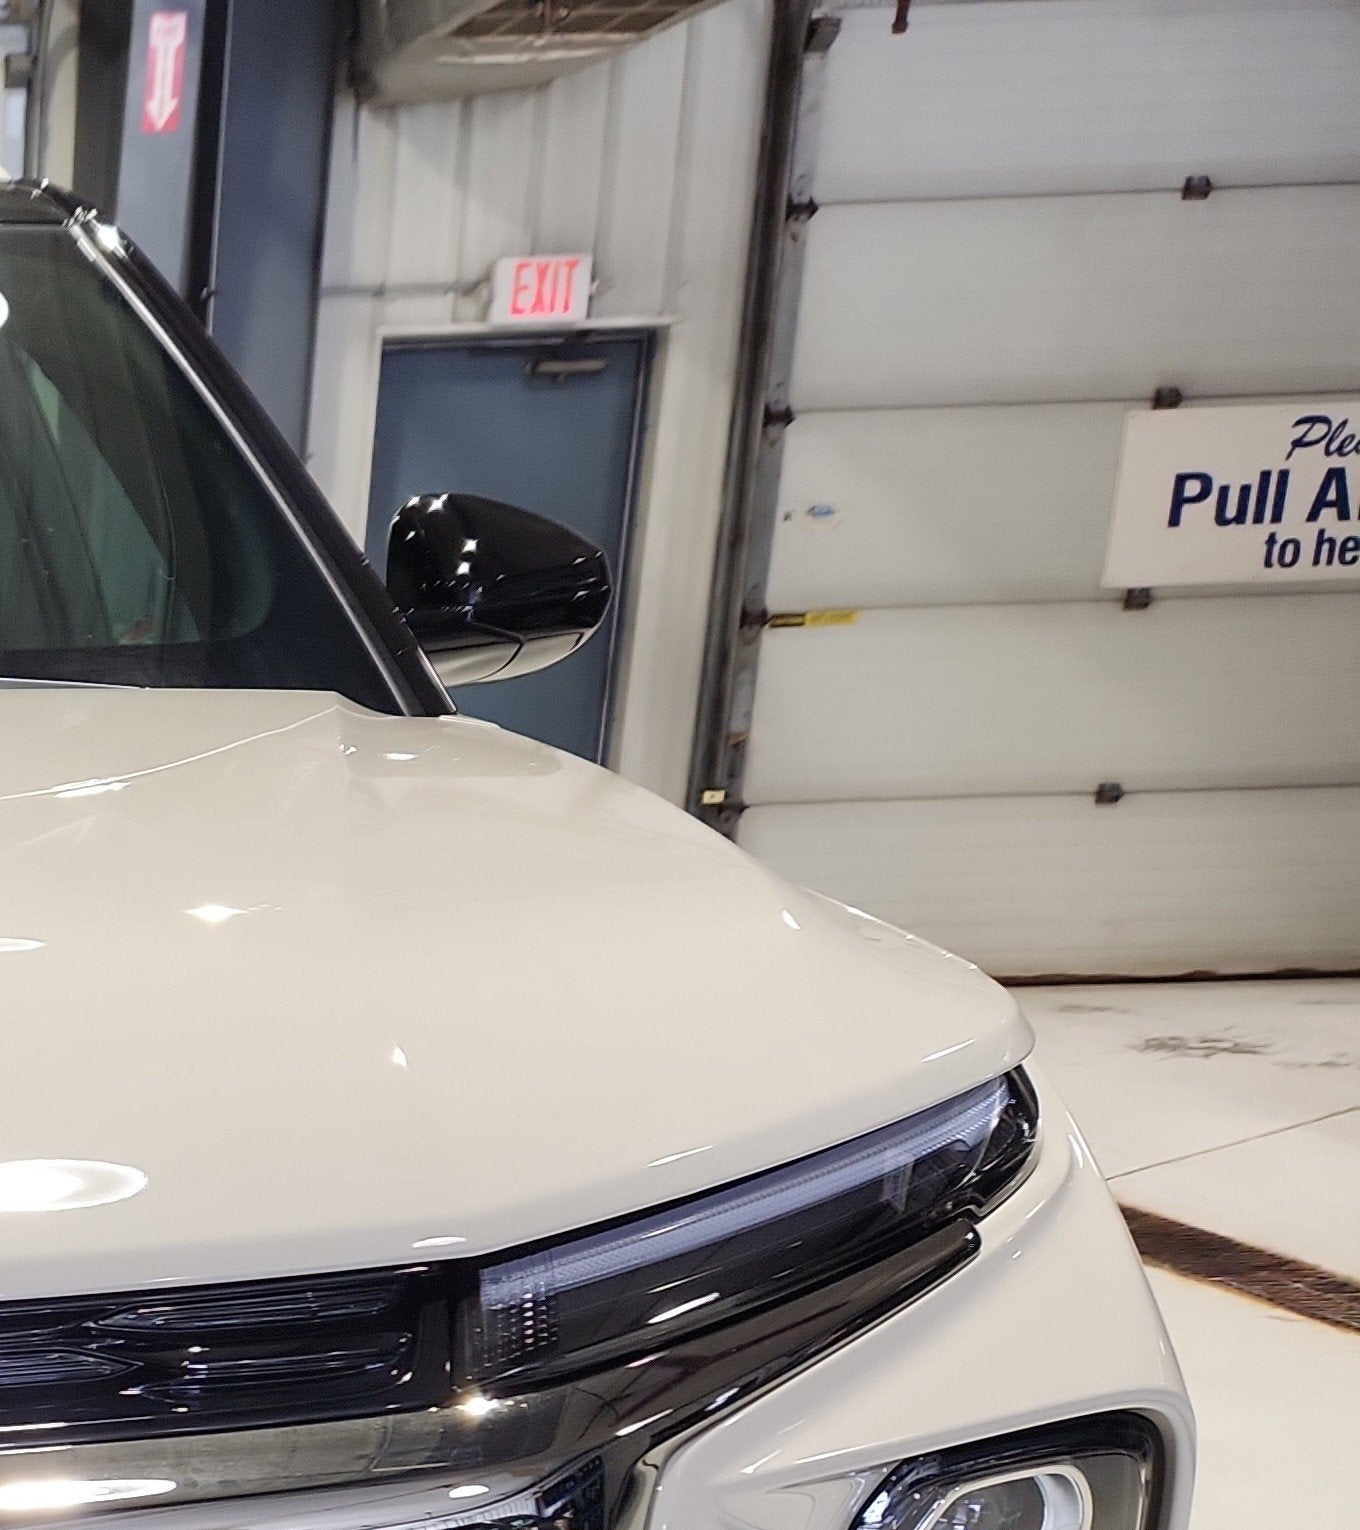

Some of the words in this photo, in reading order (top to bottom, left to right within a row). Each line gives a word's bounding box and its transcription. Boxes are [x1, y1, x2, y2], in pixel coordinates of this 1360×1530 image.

[511, 260, 580, 315] EXIT
[1168, 468, 1290, 528] Pull
[1305, 466, 1360, 522] A
[1263, 532, 1301, 569] to
